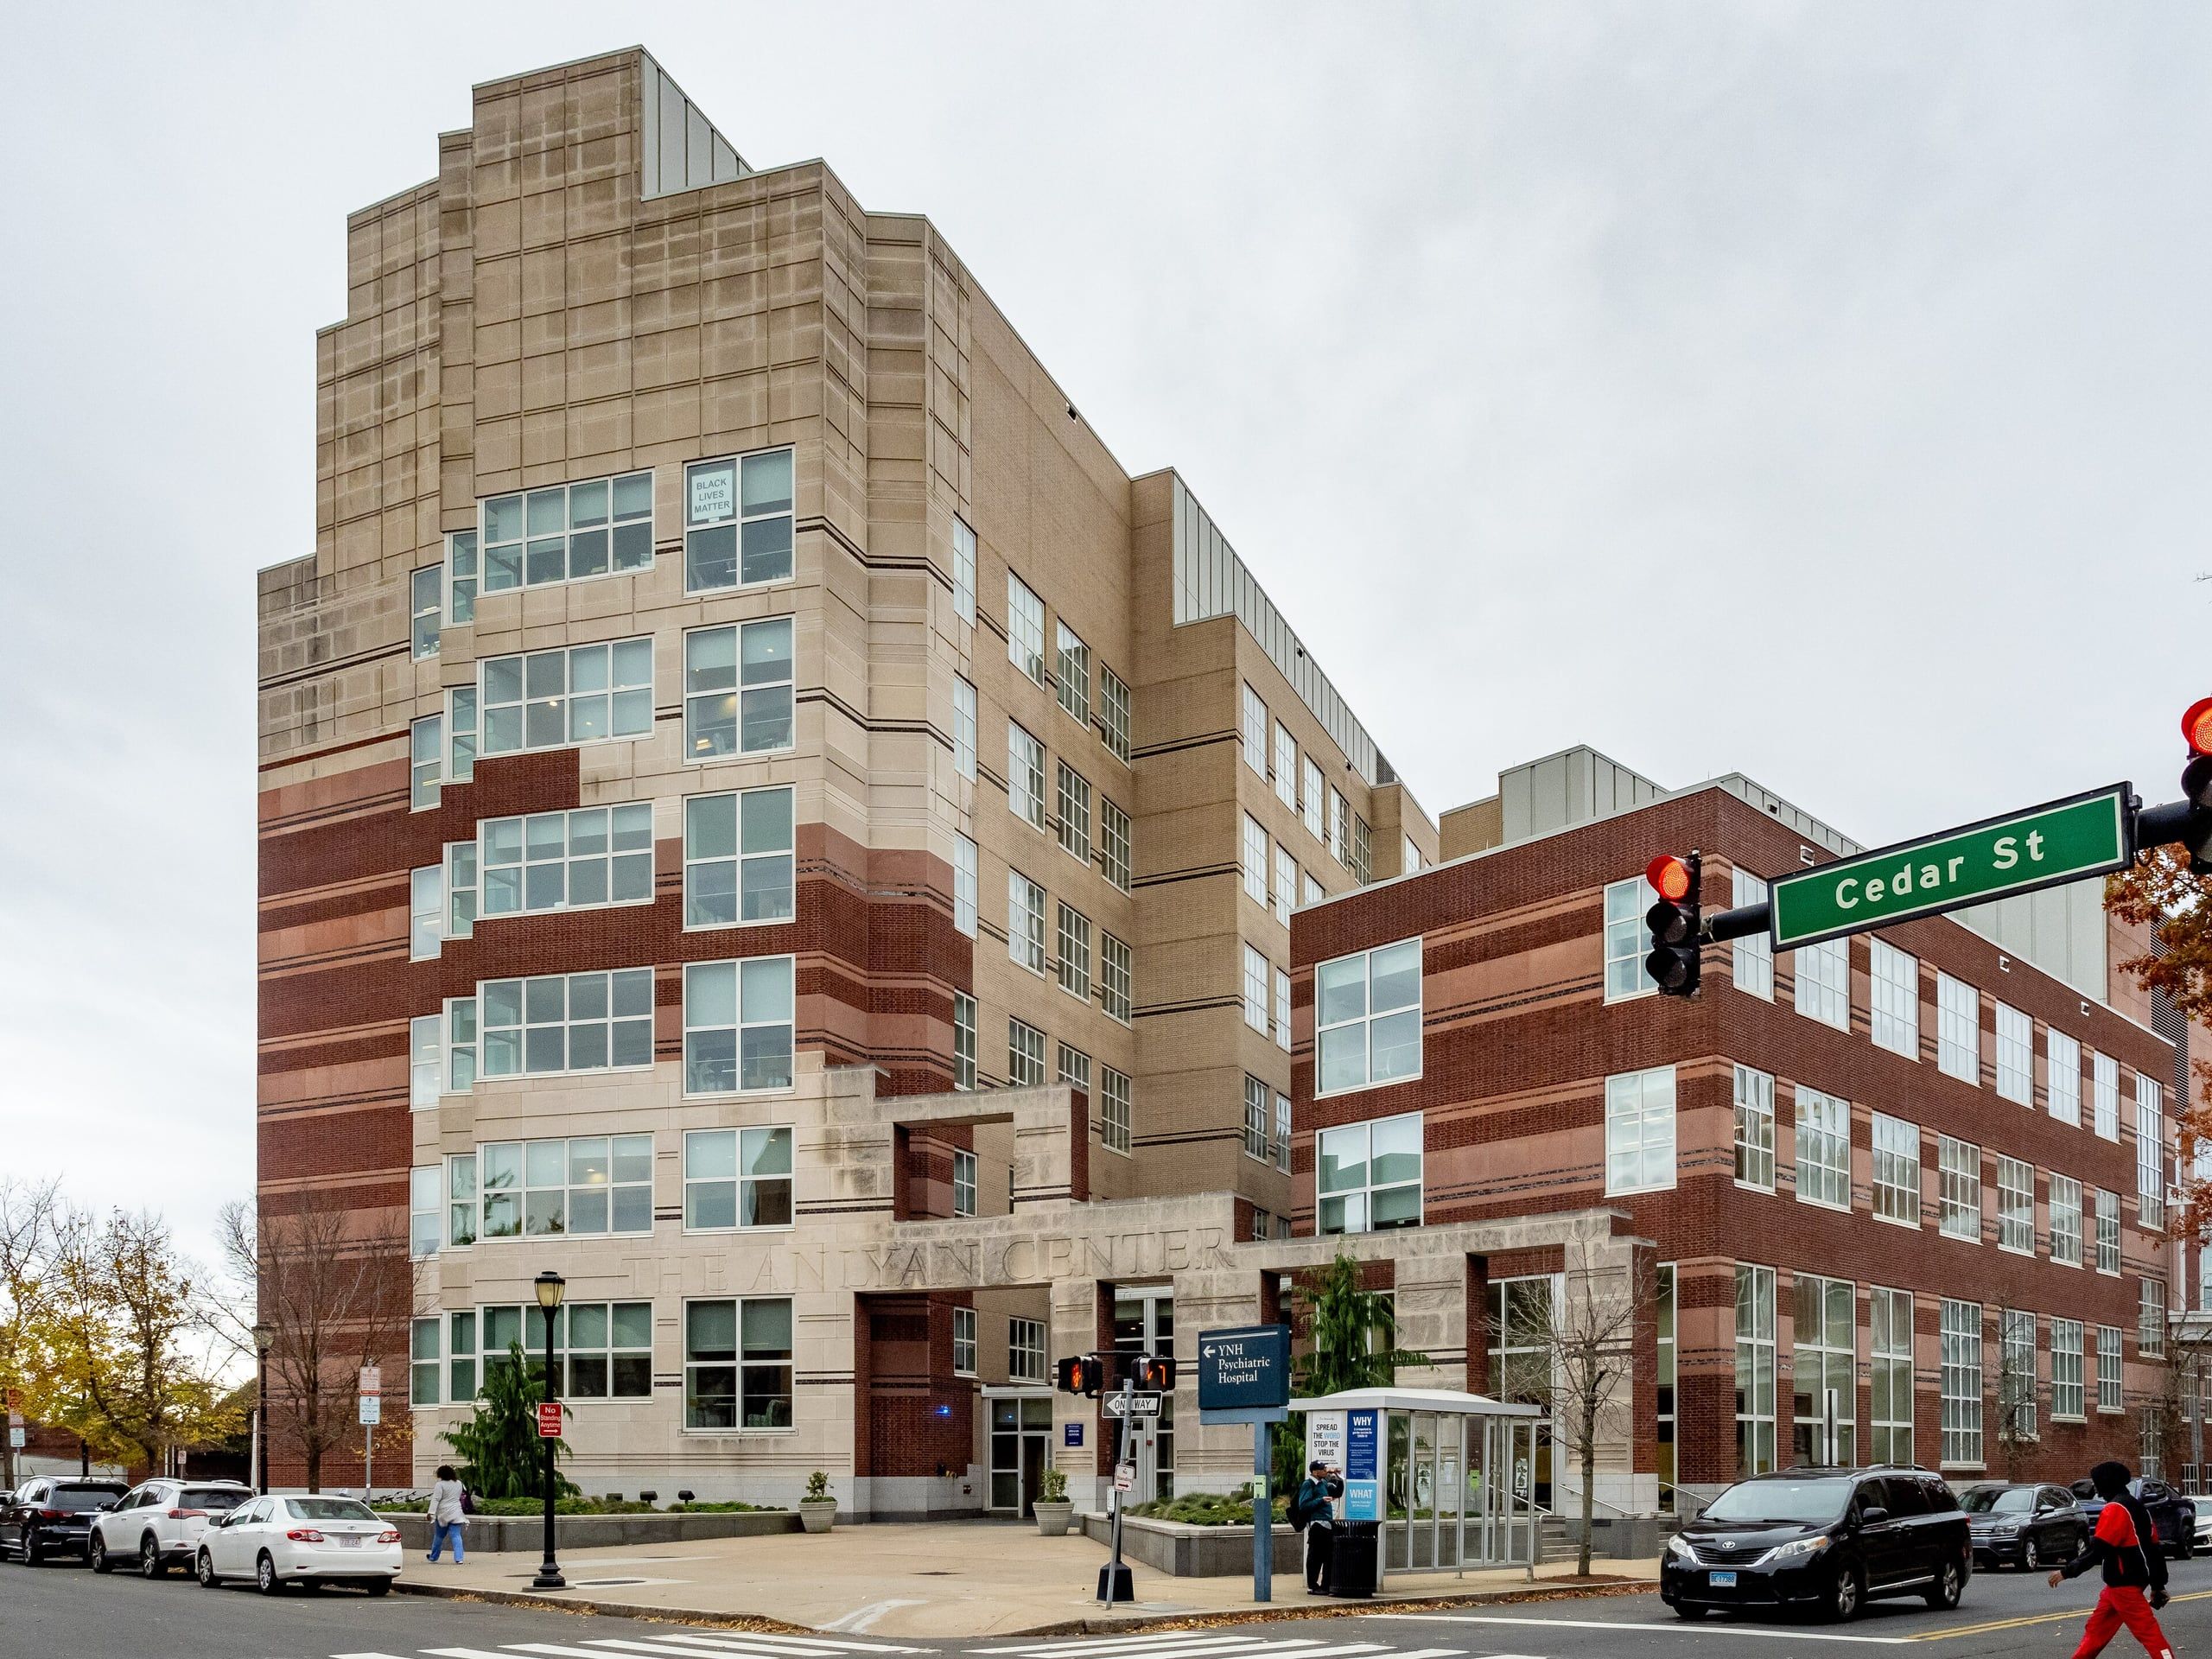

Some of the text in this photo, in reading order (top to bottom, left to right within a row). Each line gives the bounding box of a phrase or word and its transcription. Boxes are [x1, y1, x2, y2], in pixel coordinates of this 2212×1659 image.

[696, 479, 727, 490] BLACK
[699, 490, 724, 501] LIVES
[694, 501, 730, 513] MATTER
[1834, 829, 2044, 909] Cedar St
[621, 1227, 1236, 1294] THE ANLYAN CENTER
[1218, 1343, 1243, 1357] YNH
[1218, 1356, 1270, 1371] Psychiatric
[1218, 1370, 1258, 1385] Hospital
[1134, 1399, 1152, 1409] WAY
[1352, 1416, 1373, 1427] WHY
[1349, 1489, 1373, 1499] WHAT
